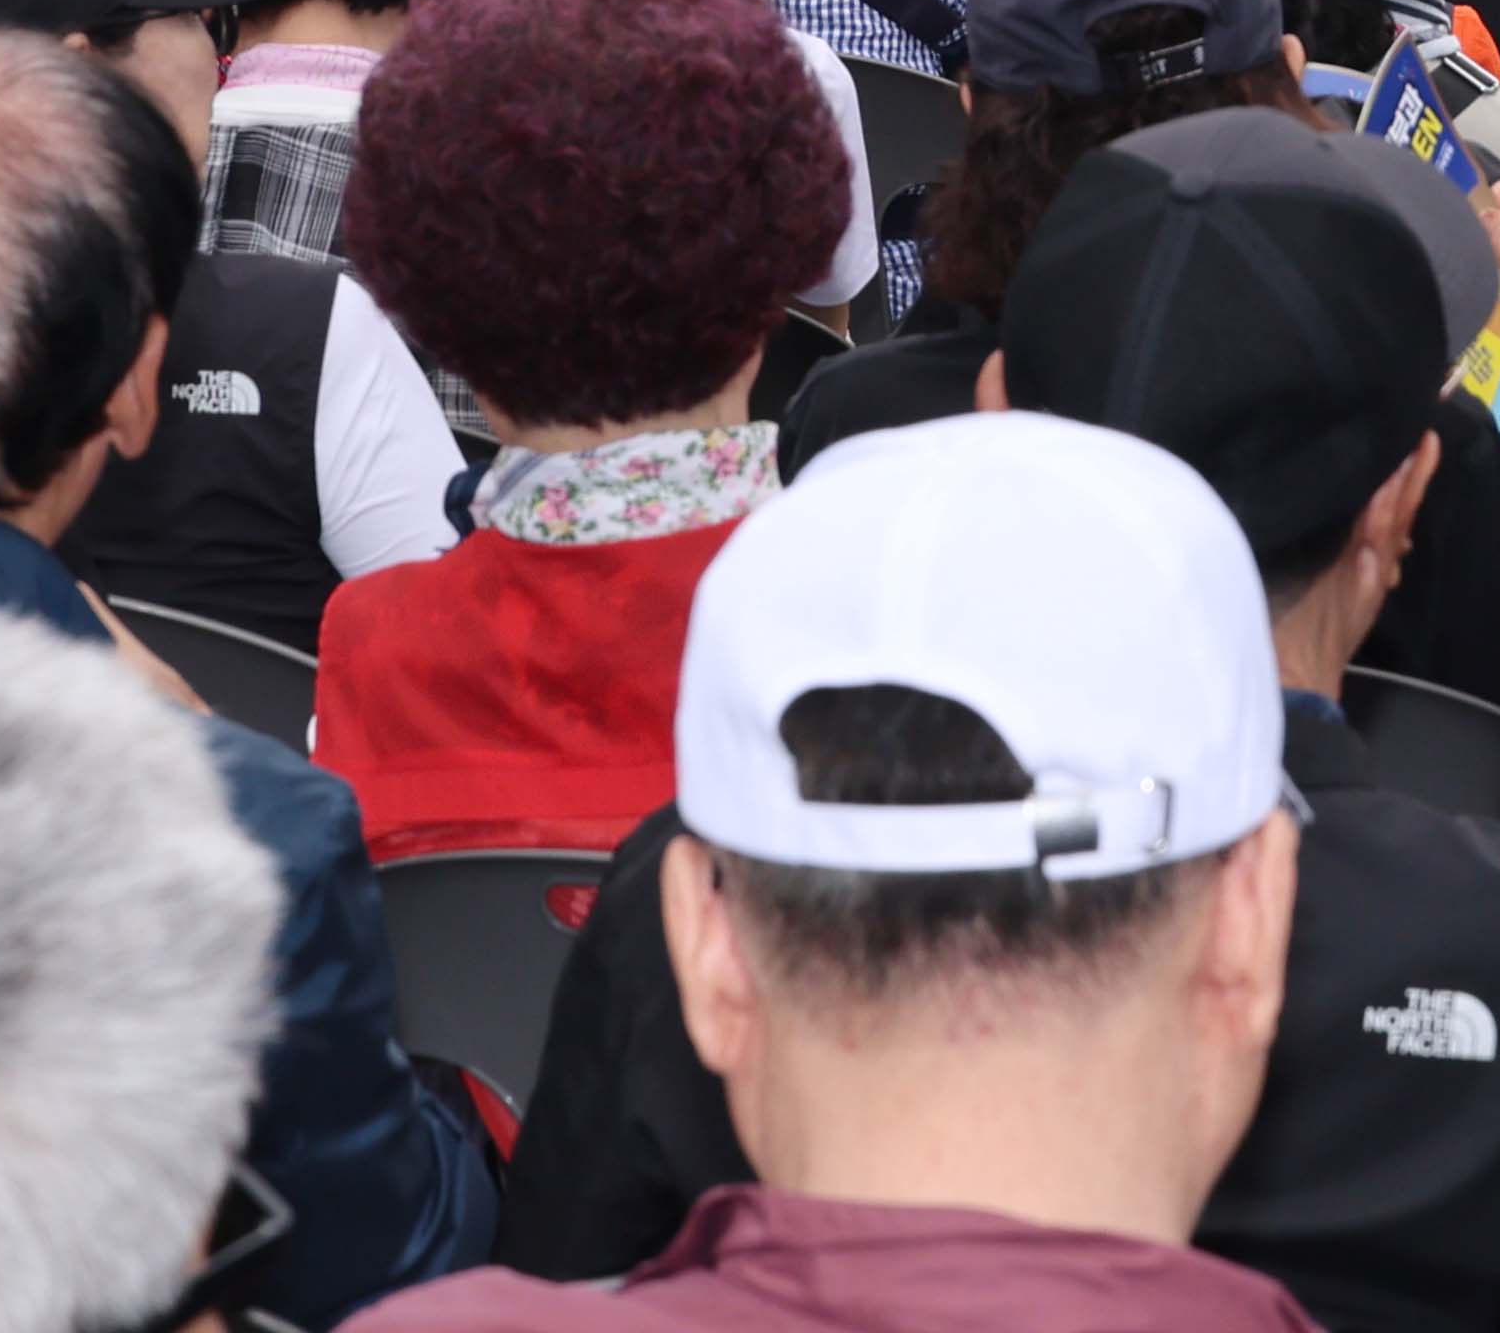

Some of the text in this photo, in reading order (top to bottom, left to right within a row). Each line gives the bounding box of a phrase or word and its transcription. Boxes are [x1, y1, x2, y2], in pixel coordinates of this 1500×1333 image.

[1411, 104, 1445, 163] EN
[198, 369, 230, 386] THE
[172, 383, 230, 400] NORTH
[188, 398, 230, 414] FACE
[1404, 987, 1453, 1011] THE
[1362, 1006, 1448, 1033] NORTH
[1386, 1031, 1450, 1059] FACE
